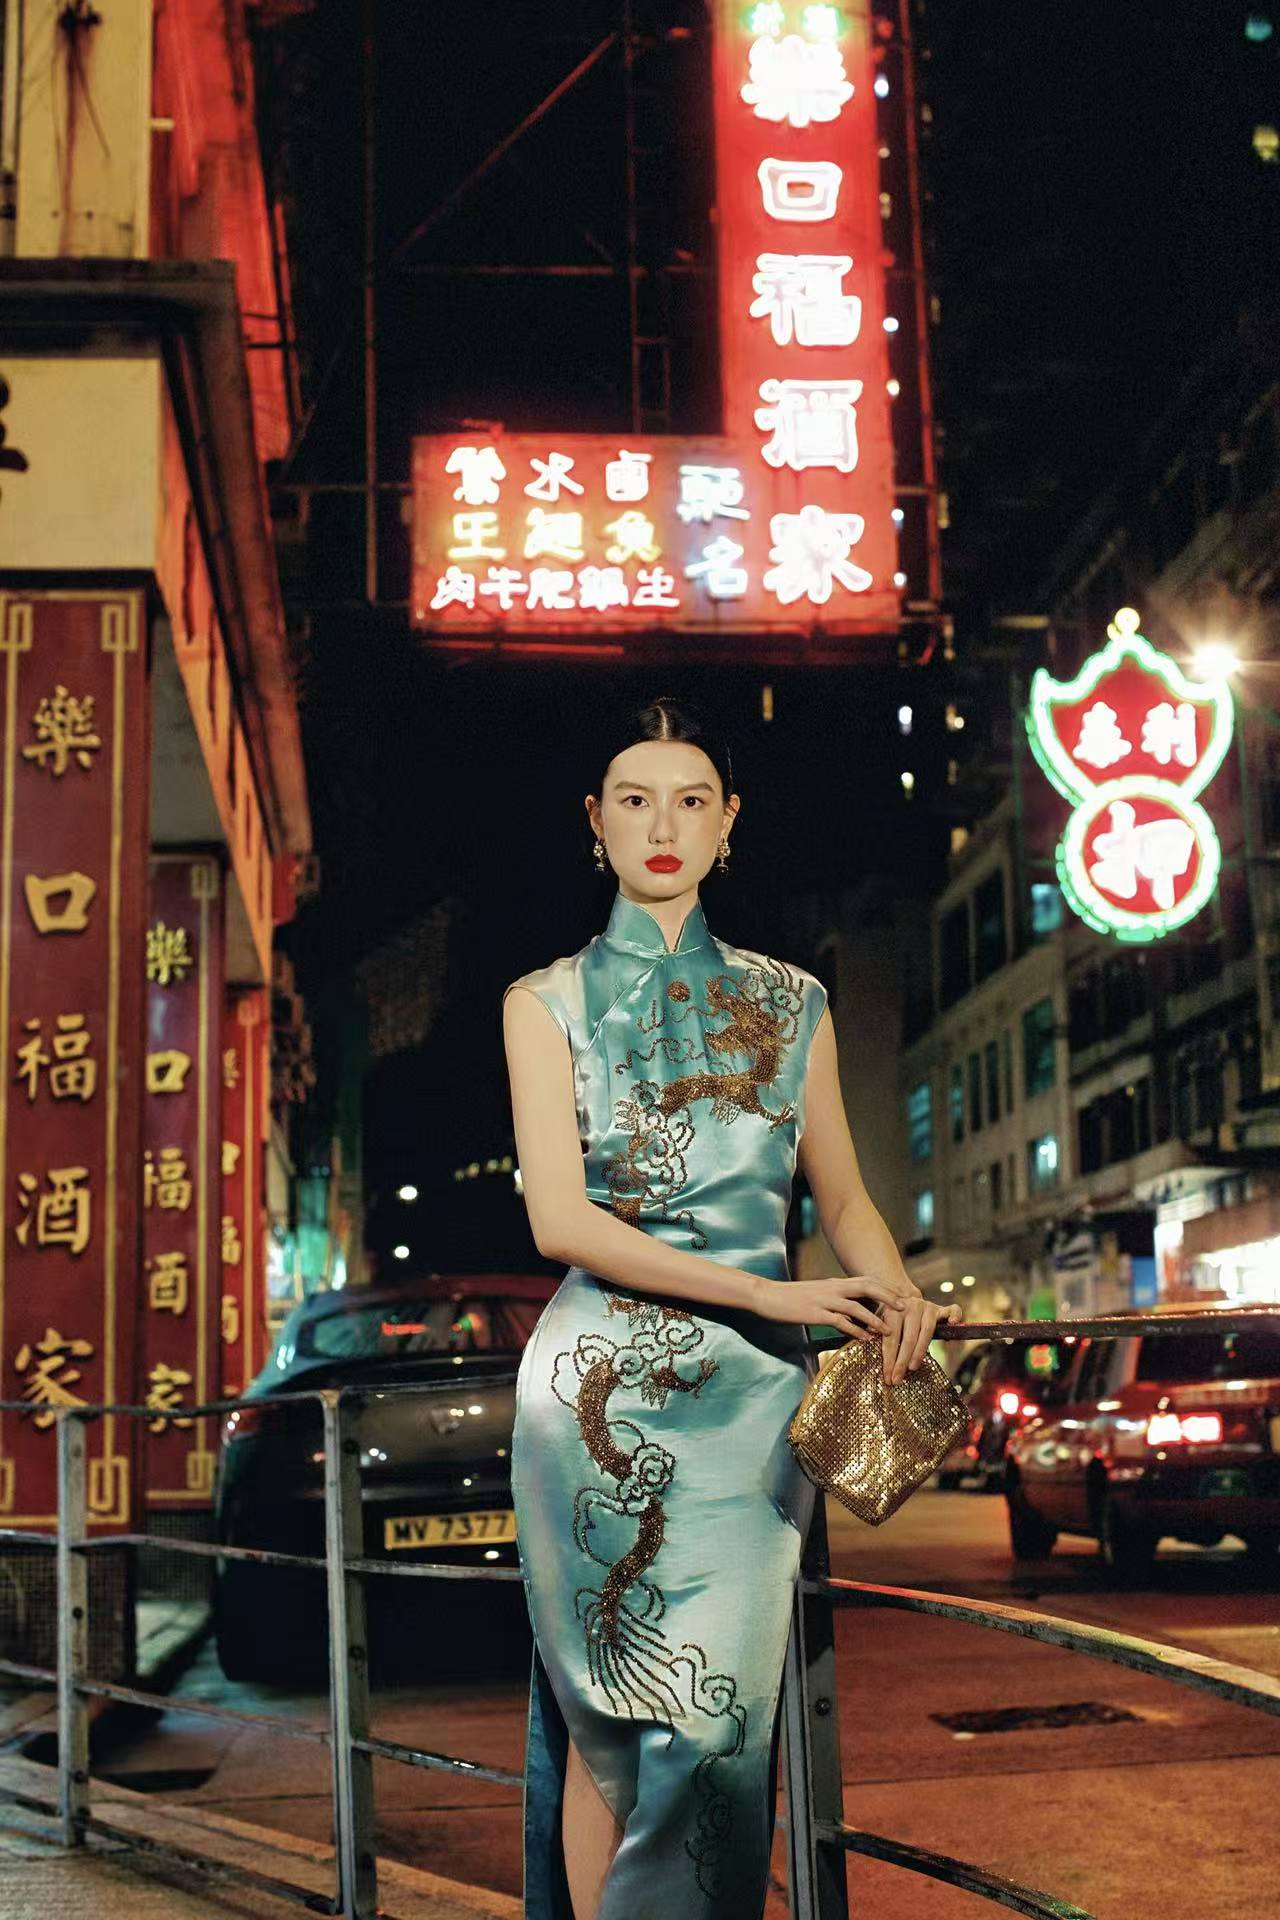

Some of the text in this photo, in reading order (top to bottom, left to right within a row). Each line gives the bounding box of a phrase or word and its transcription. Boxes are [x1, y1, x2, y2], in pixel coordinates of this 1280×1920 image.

[15, 684, 101, 1430] 樂口福酒家
[439, 1513, 509, 1541] 7377
